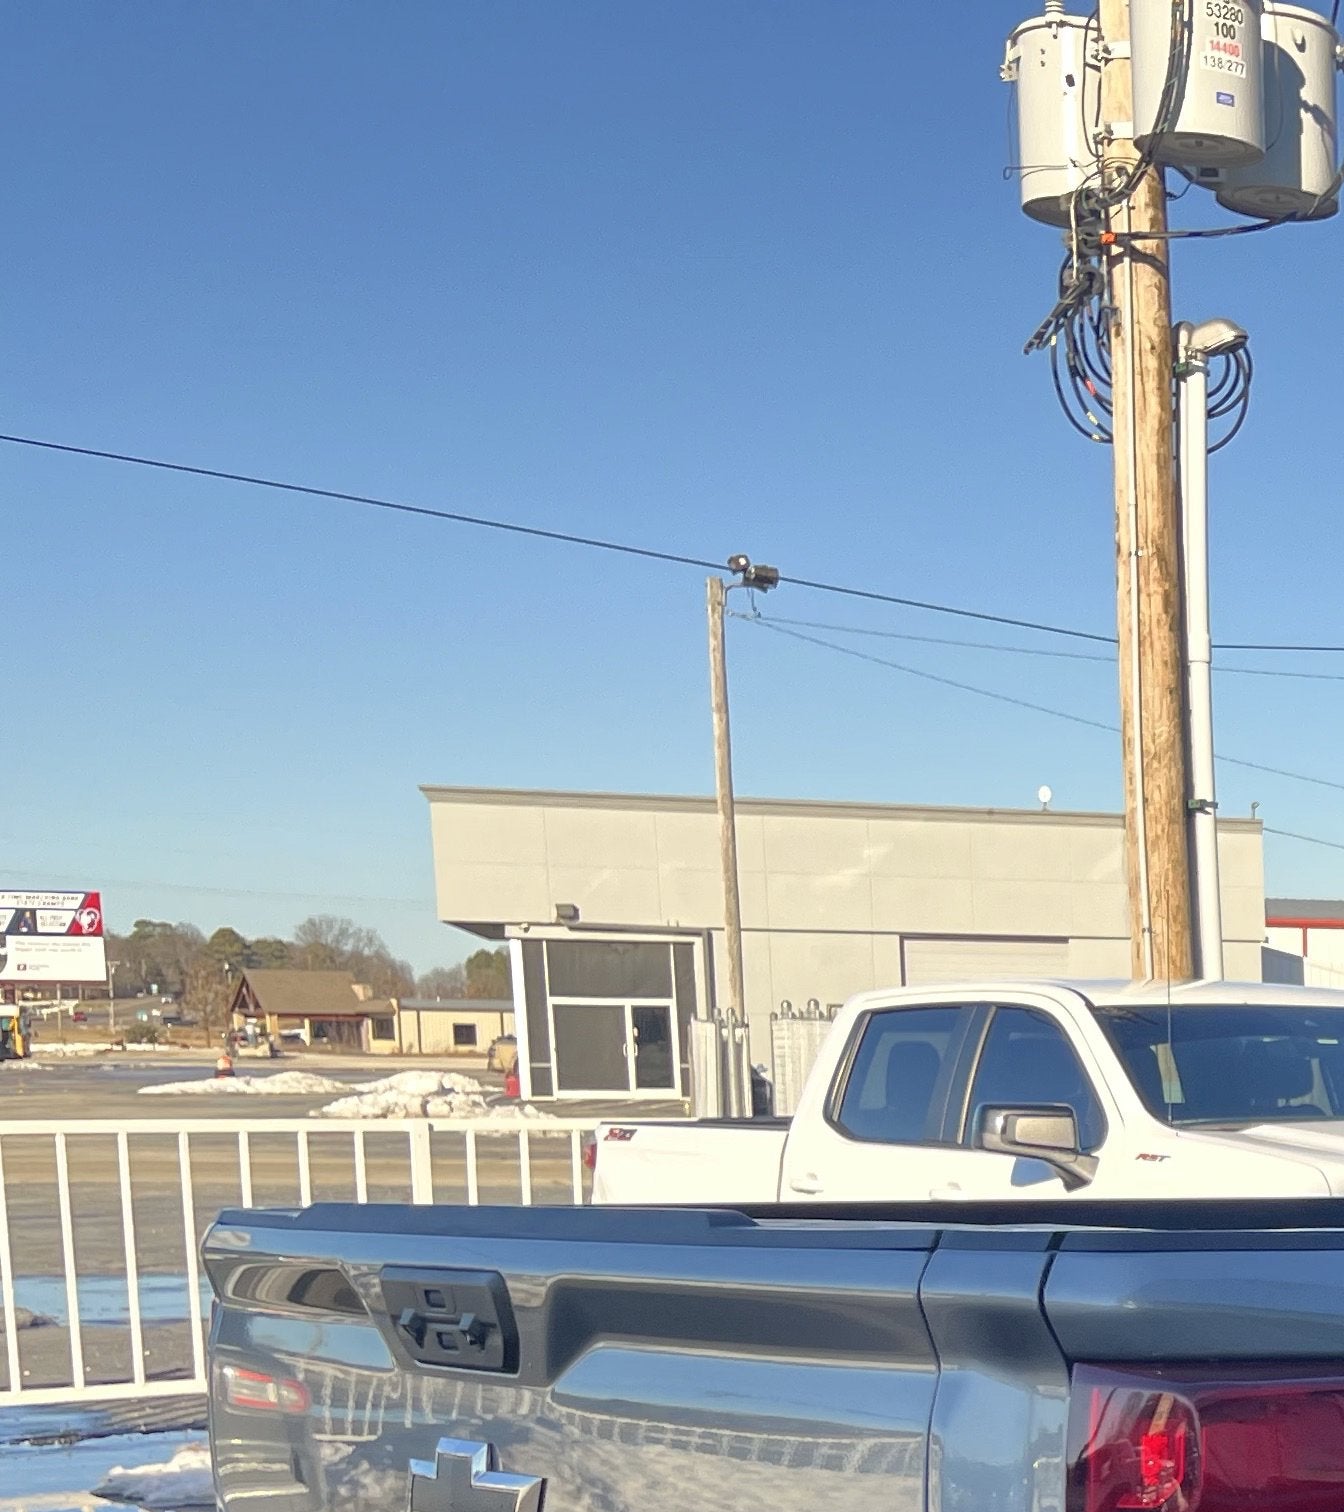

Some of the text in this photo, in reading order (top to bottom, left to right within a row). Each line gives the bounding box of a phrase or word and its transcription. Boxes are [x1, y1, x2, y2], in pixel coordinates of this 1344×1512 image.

[1206, 2, 1243, 25] 53280
[1214, 22, 1236, 40] 100
[1135, 1153, 1171, 1162] RST
